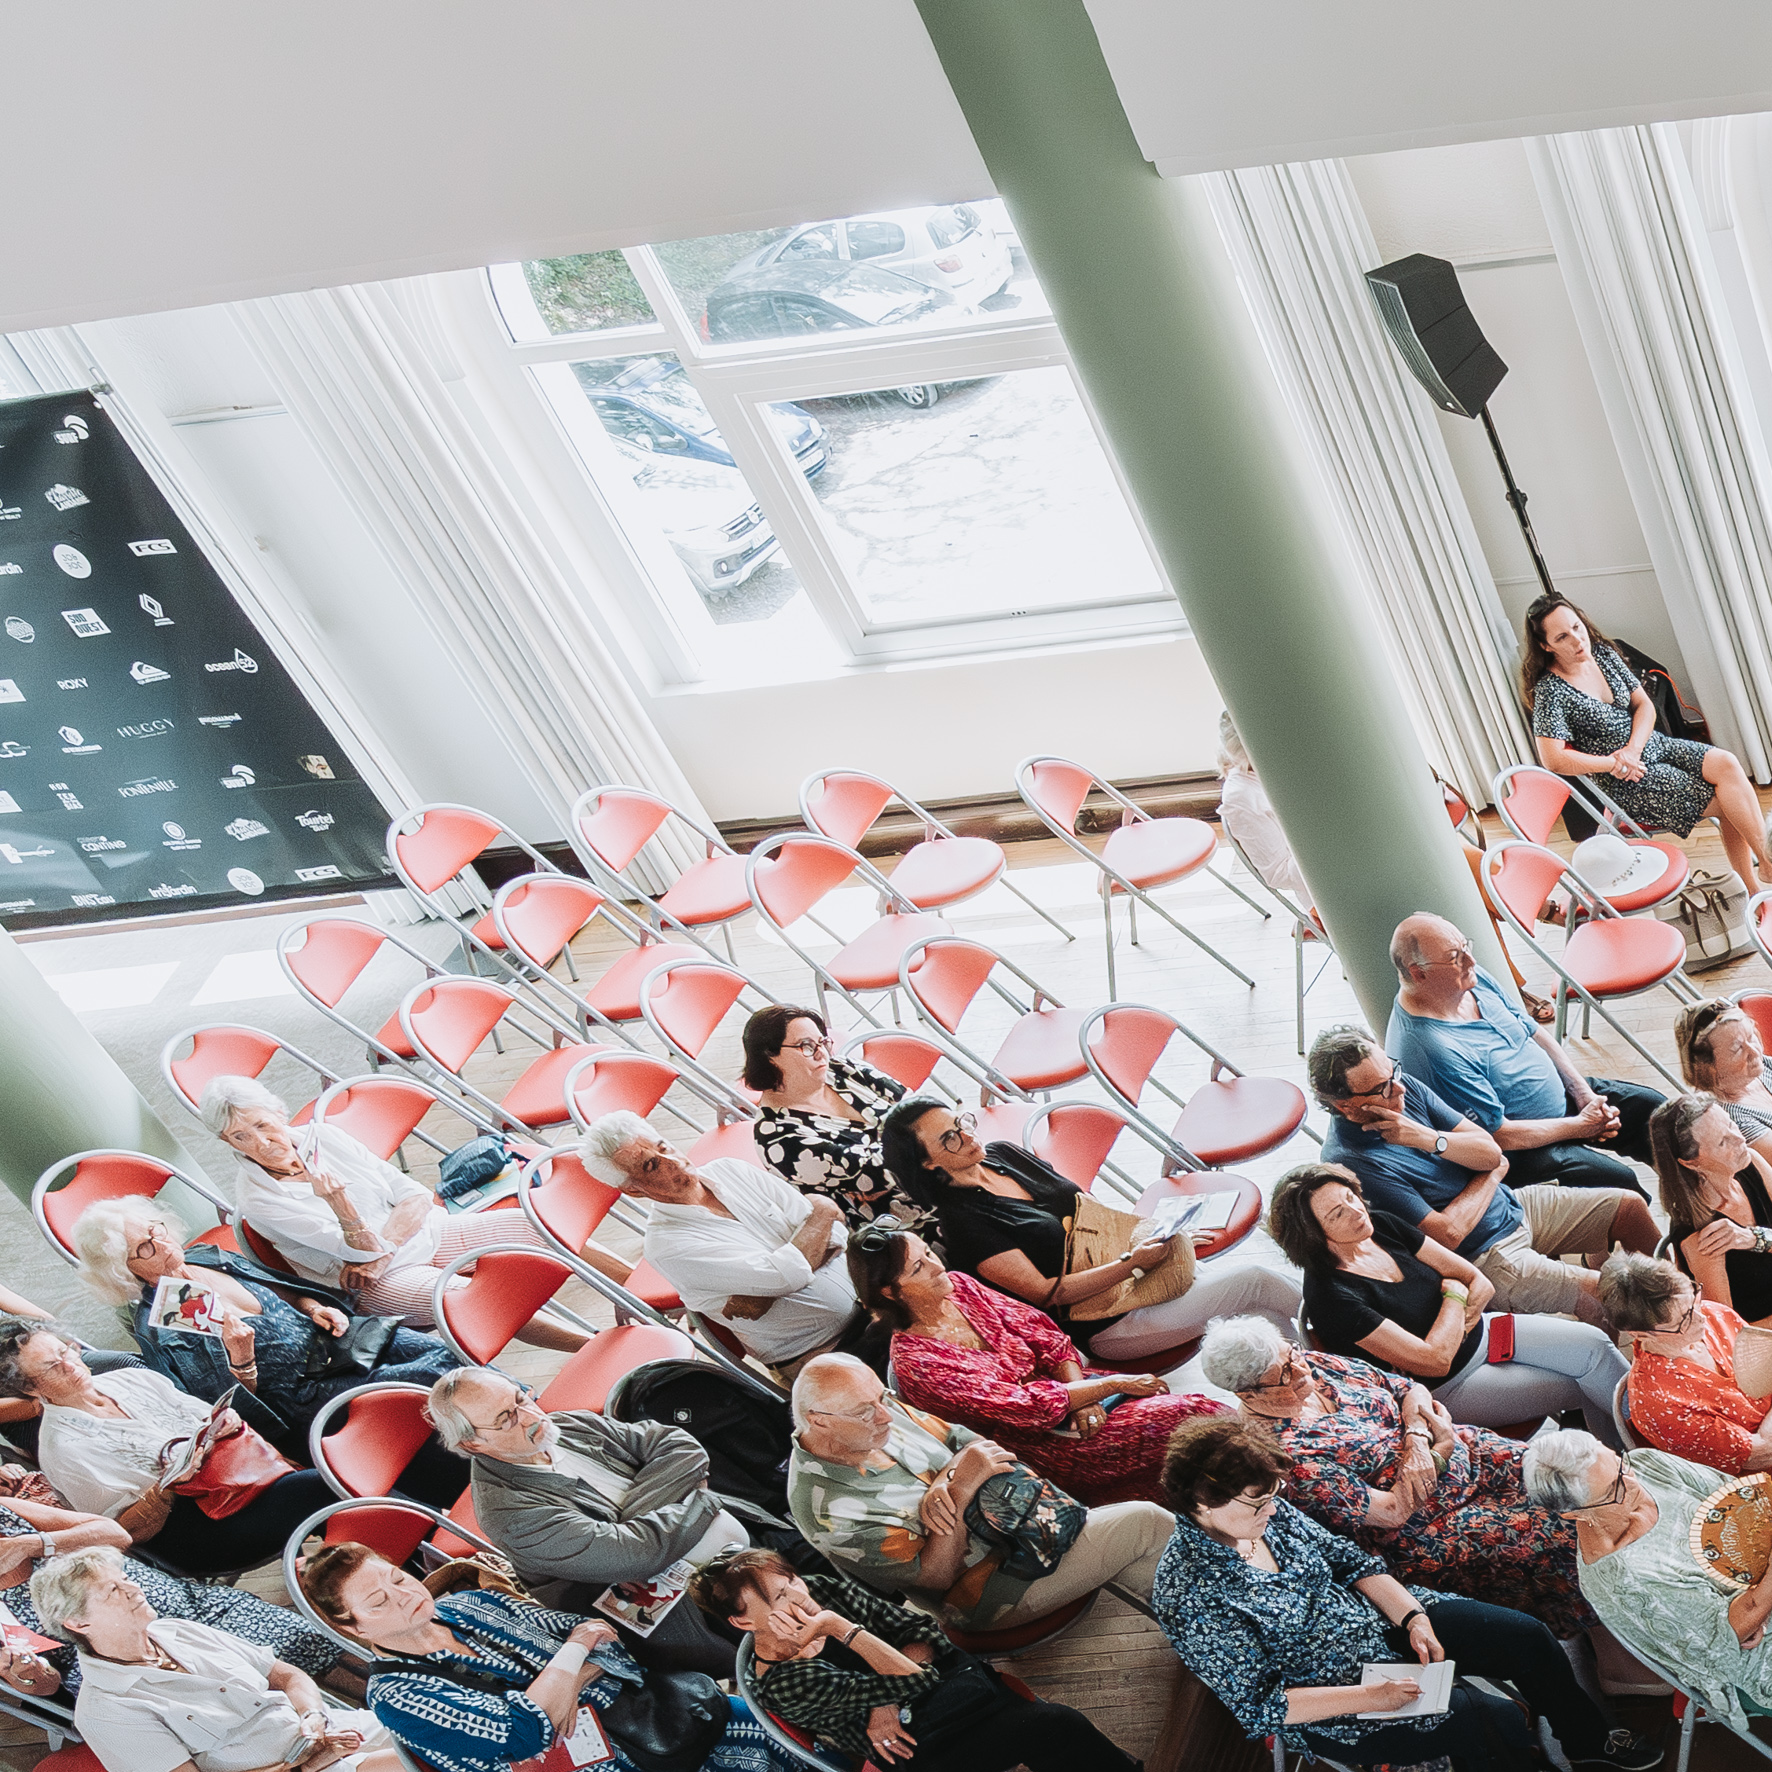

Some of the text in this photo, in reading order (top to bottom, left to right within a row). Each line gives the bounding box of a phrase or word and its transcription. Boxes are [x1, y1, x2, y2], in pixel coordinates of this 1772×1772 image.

[67, 612, 87, 624] SUD
[75, 621, 105, 634] OUEST
[204, 660, 238, 673] ocean
[56, 677, 89, 690] ROXY
[116, 718, 175, 738] HUGGY
